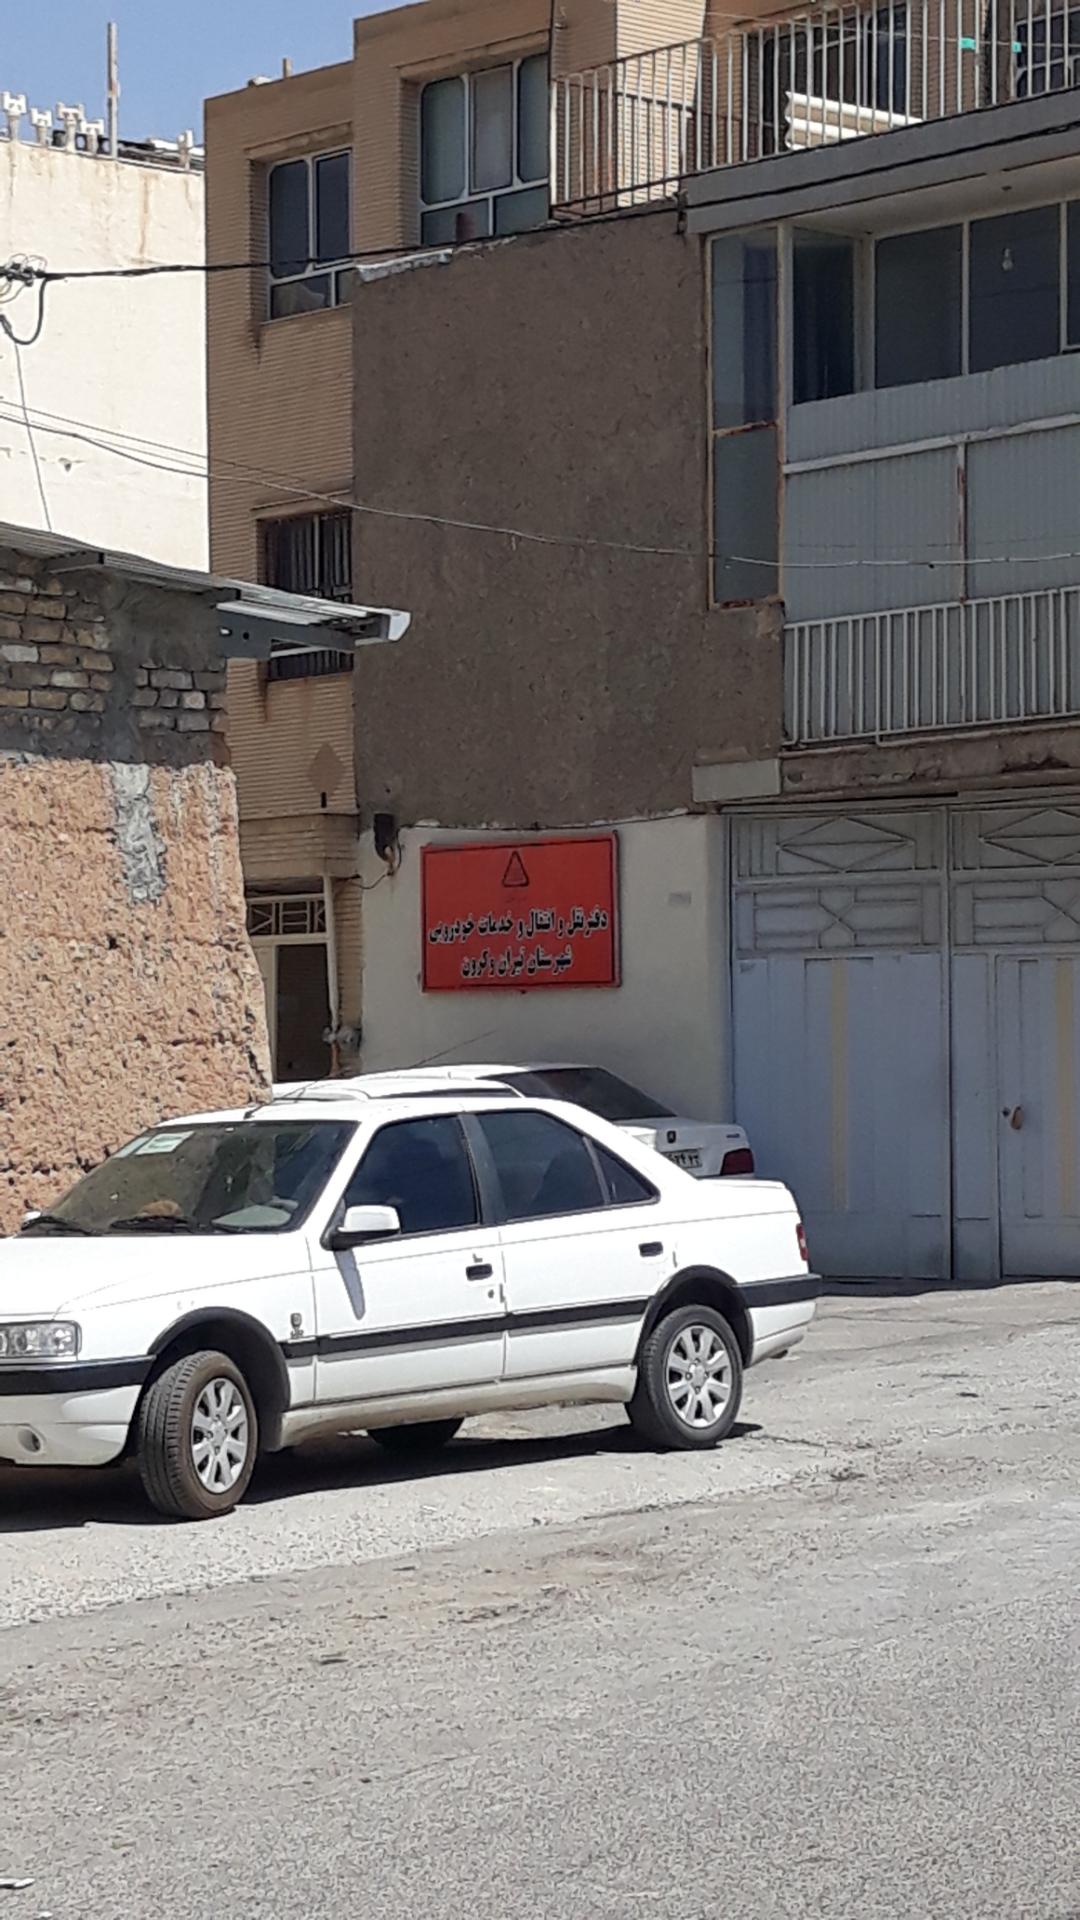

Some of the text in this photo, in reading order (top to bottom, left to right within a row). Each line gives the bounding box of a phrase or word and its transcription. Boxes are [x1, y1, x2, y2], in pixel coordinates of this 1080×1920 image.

[478, 911, 513, 935] خدمات
[517, 918, 524, 938] و
[526, 908, 555, 937] انتقال
[557, 918, 563, 938] و
[567, 907, 584, 937] نقل
[585, 905, 607, 937] دفتر
[497, 946, 526, 976] تیران
[527, 944, 572, 975] شهرستان
